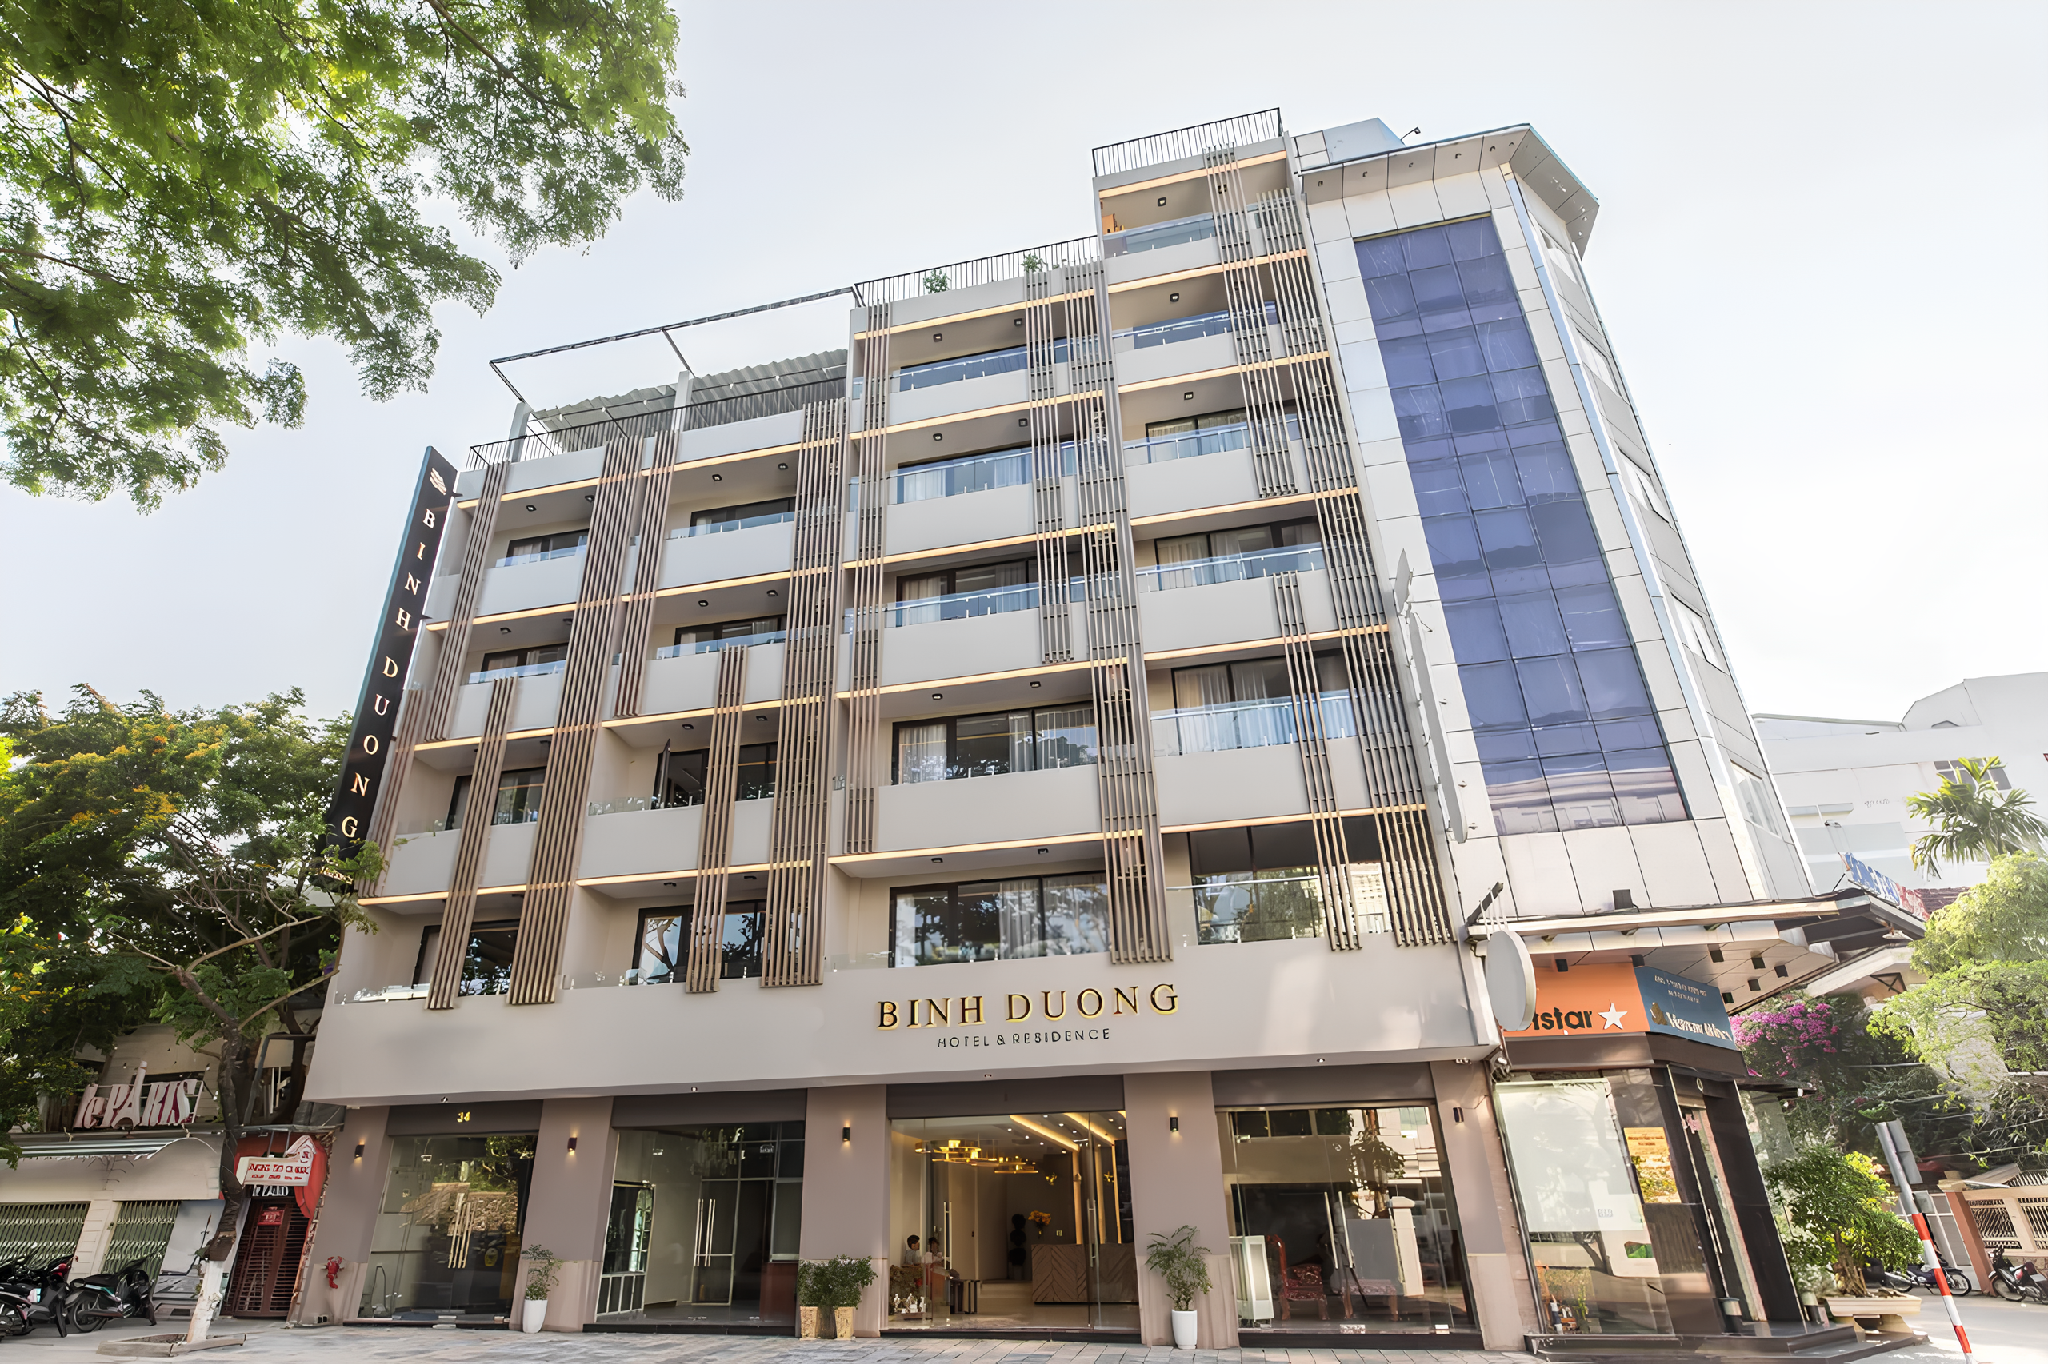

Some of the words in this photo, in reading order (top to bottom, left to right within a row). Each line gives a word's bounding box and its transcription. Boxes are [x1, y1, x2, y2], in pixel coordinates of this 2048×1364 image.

[396, 508, 436, 632] BINH
[341, 655, 399, 838] DUONG
[877, 995, 986, 1031] BINH
[1005, 983, 1179, 1023] DUONG
[936, 1035, 990, 1049] HOTEL
[996, 1033, 1006, 1046] &
[1012, 1028, 1111, 1045] RESIDENCE
